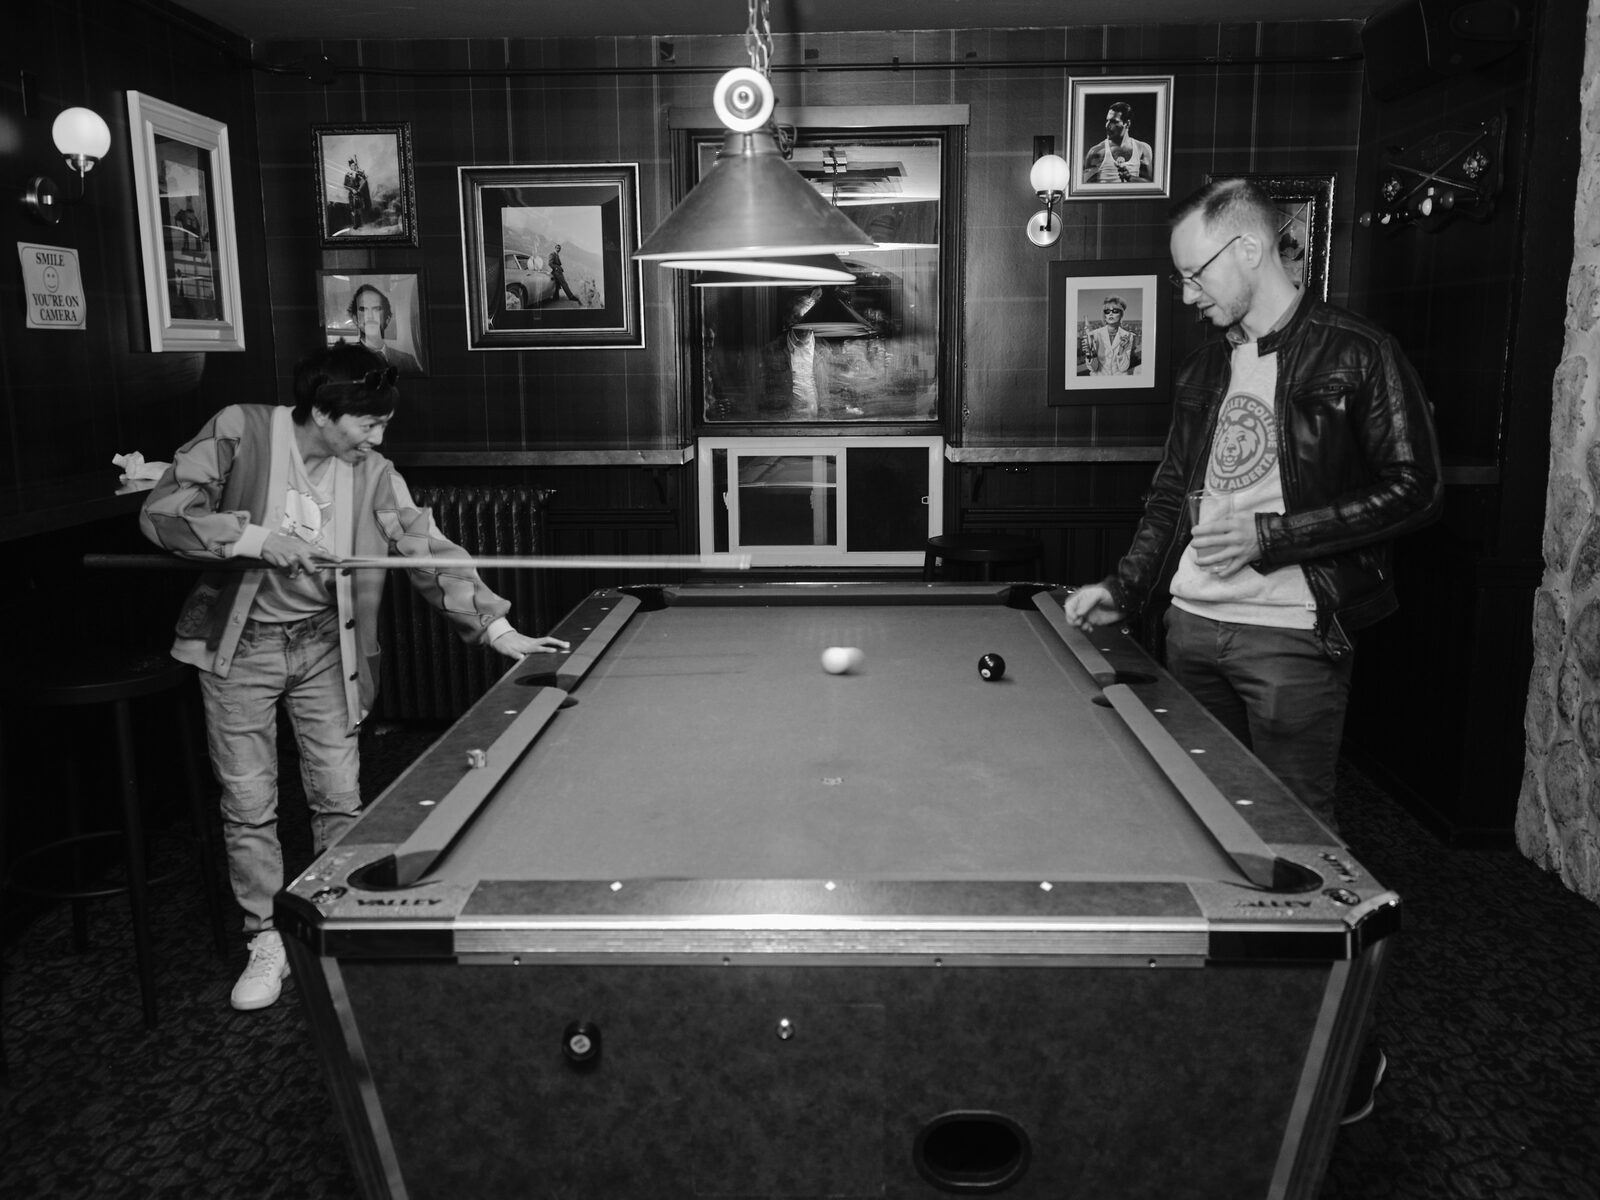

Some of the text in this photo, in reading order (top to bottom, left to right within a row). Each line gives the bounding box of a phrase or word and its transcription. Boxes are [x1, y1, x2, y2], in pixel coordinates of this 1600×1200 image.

[35, 252, 65, 267] SMILE
[32, 293, 79, 307] YOU'RE ON
[40, 308, 77, 321] CAMERA
[1247, 401, 1277, 448] COLLEGE
[1228, 453, 1276, 490] ALBERTA
